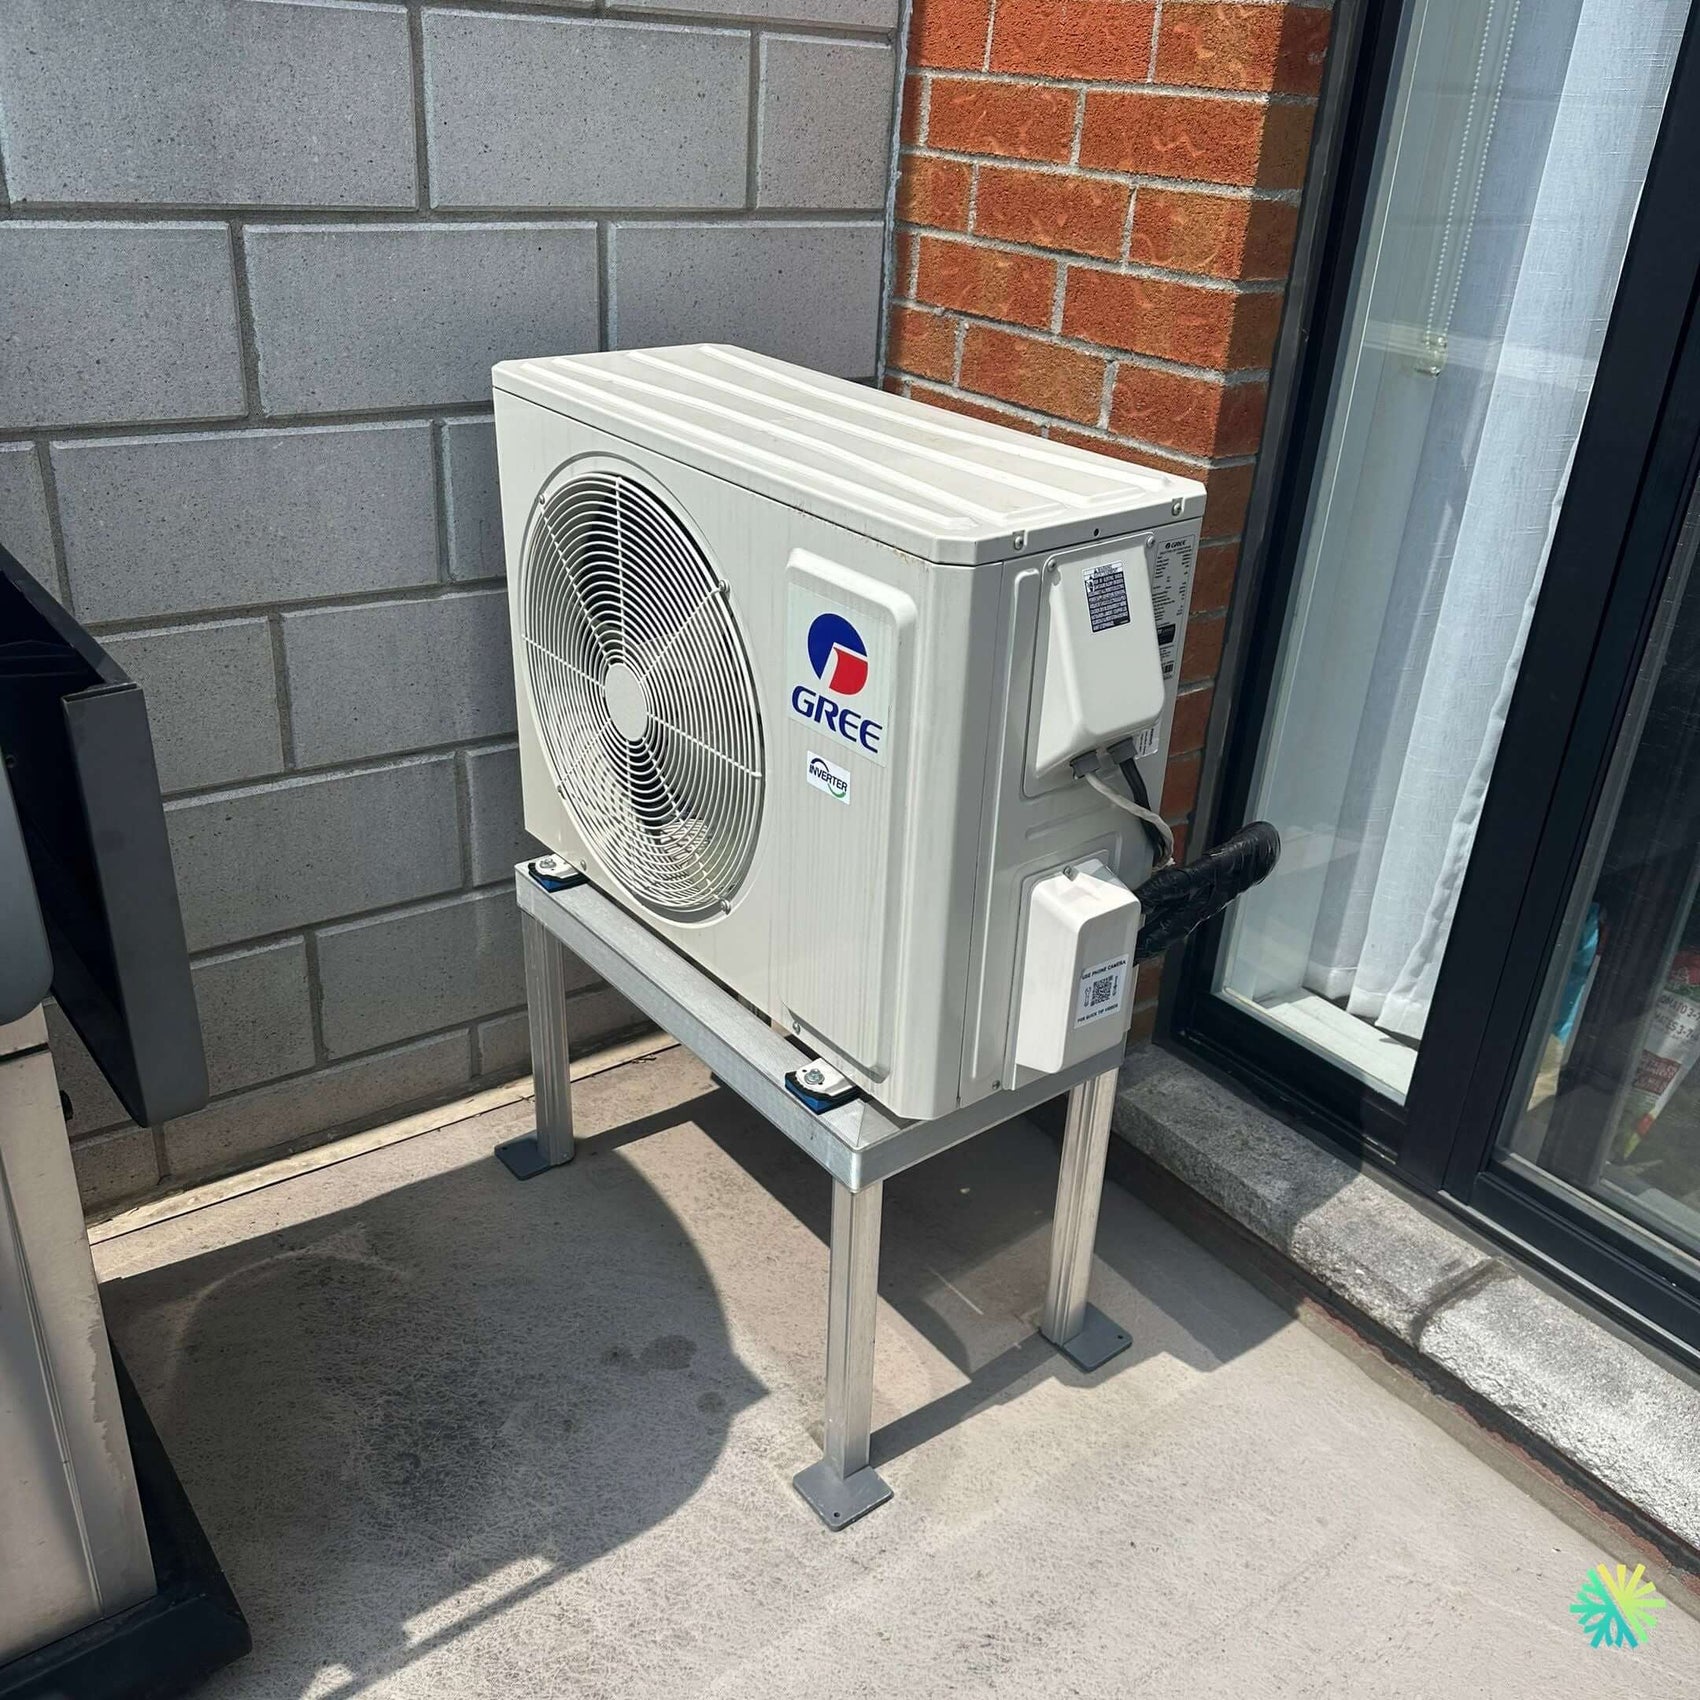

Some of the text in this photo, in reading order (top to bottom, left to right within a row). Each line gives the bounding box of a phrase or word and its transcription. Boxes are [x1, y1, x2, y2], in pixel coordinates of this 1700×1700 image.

[791, 685, 883, 754] GREE
[809, 764, 848, 793] INVERTER
[1092, 967, 1107, 976] PHONE
[1107, 960, 1126, 970] CAMERA
